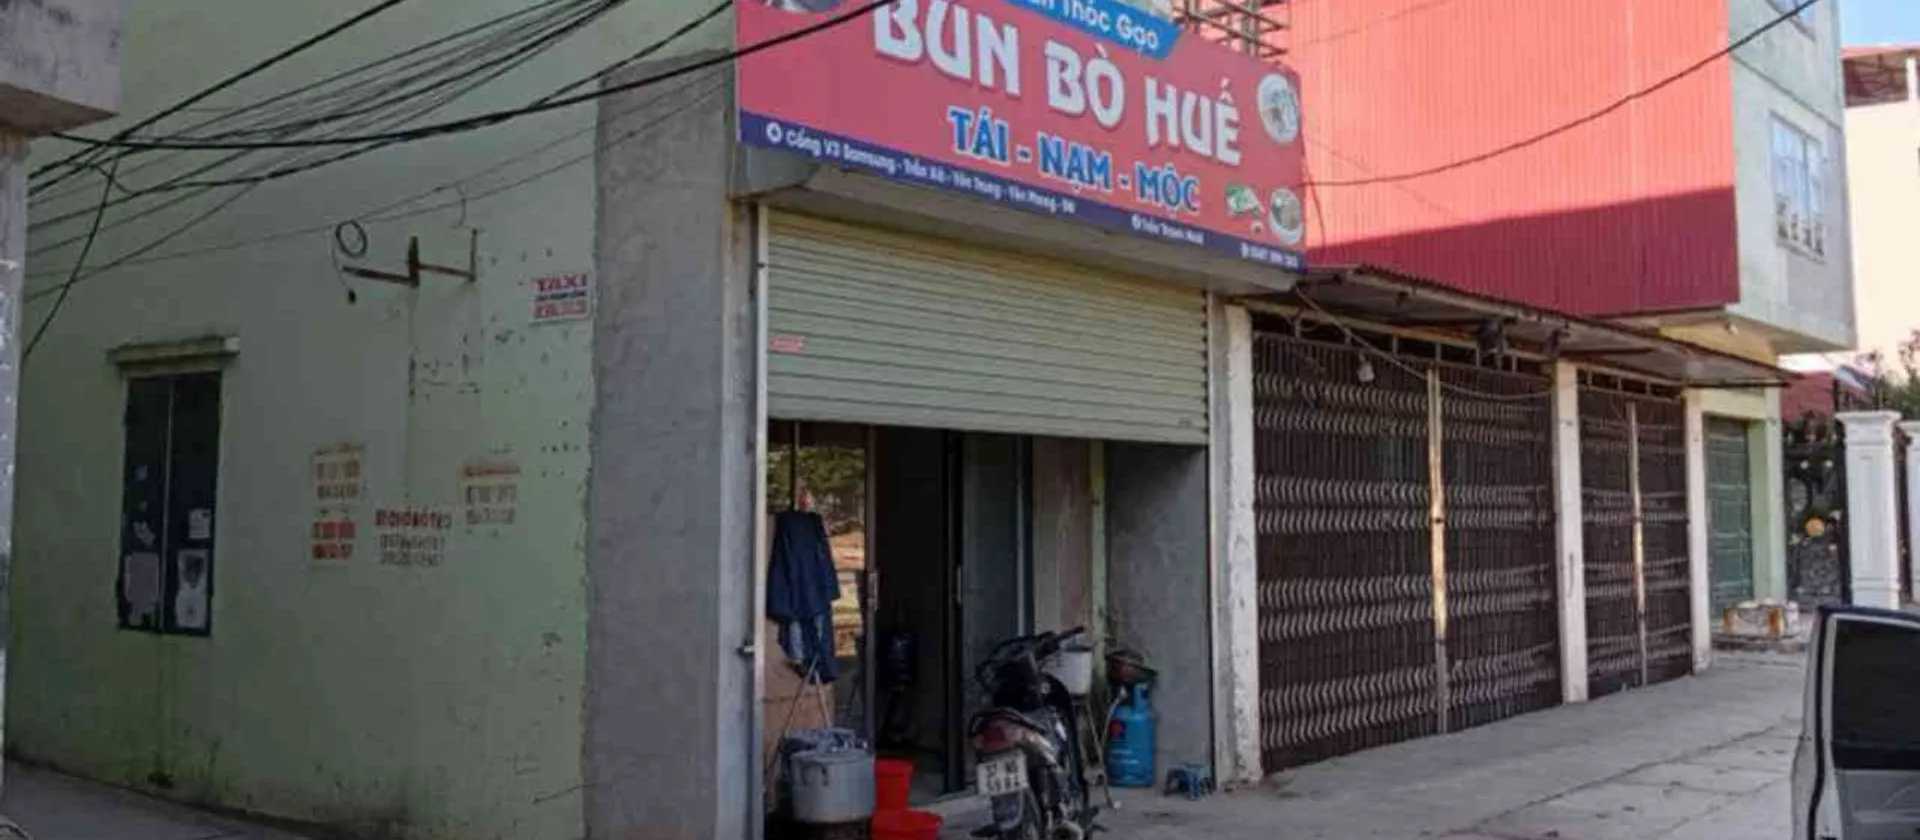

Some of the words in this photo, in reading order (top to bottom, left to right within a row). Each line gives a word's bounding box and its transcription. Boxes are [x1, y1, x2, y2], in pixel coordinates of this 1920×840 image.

[1116, 13, 1159, 54] Gạo
[1043, 39, 1124, 127] BÒ
[1144, 77, 1241, 165] HUẾ
[948, 105, 1010, 164] TÁI
[1037, 130, 1112, 194] NẠM
[1134, 160, 1201, 218] MỘC
[533, 274, 588, 292] TAXI
